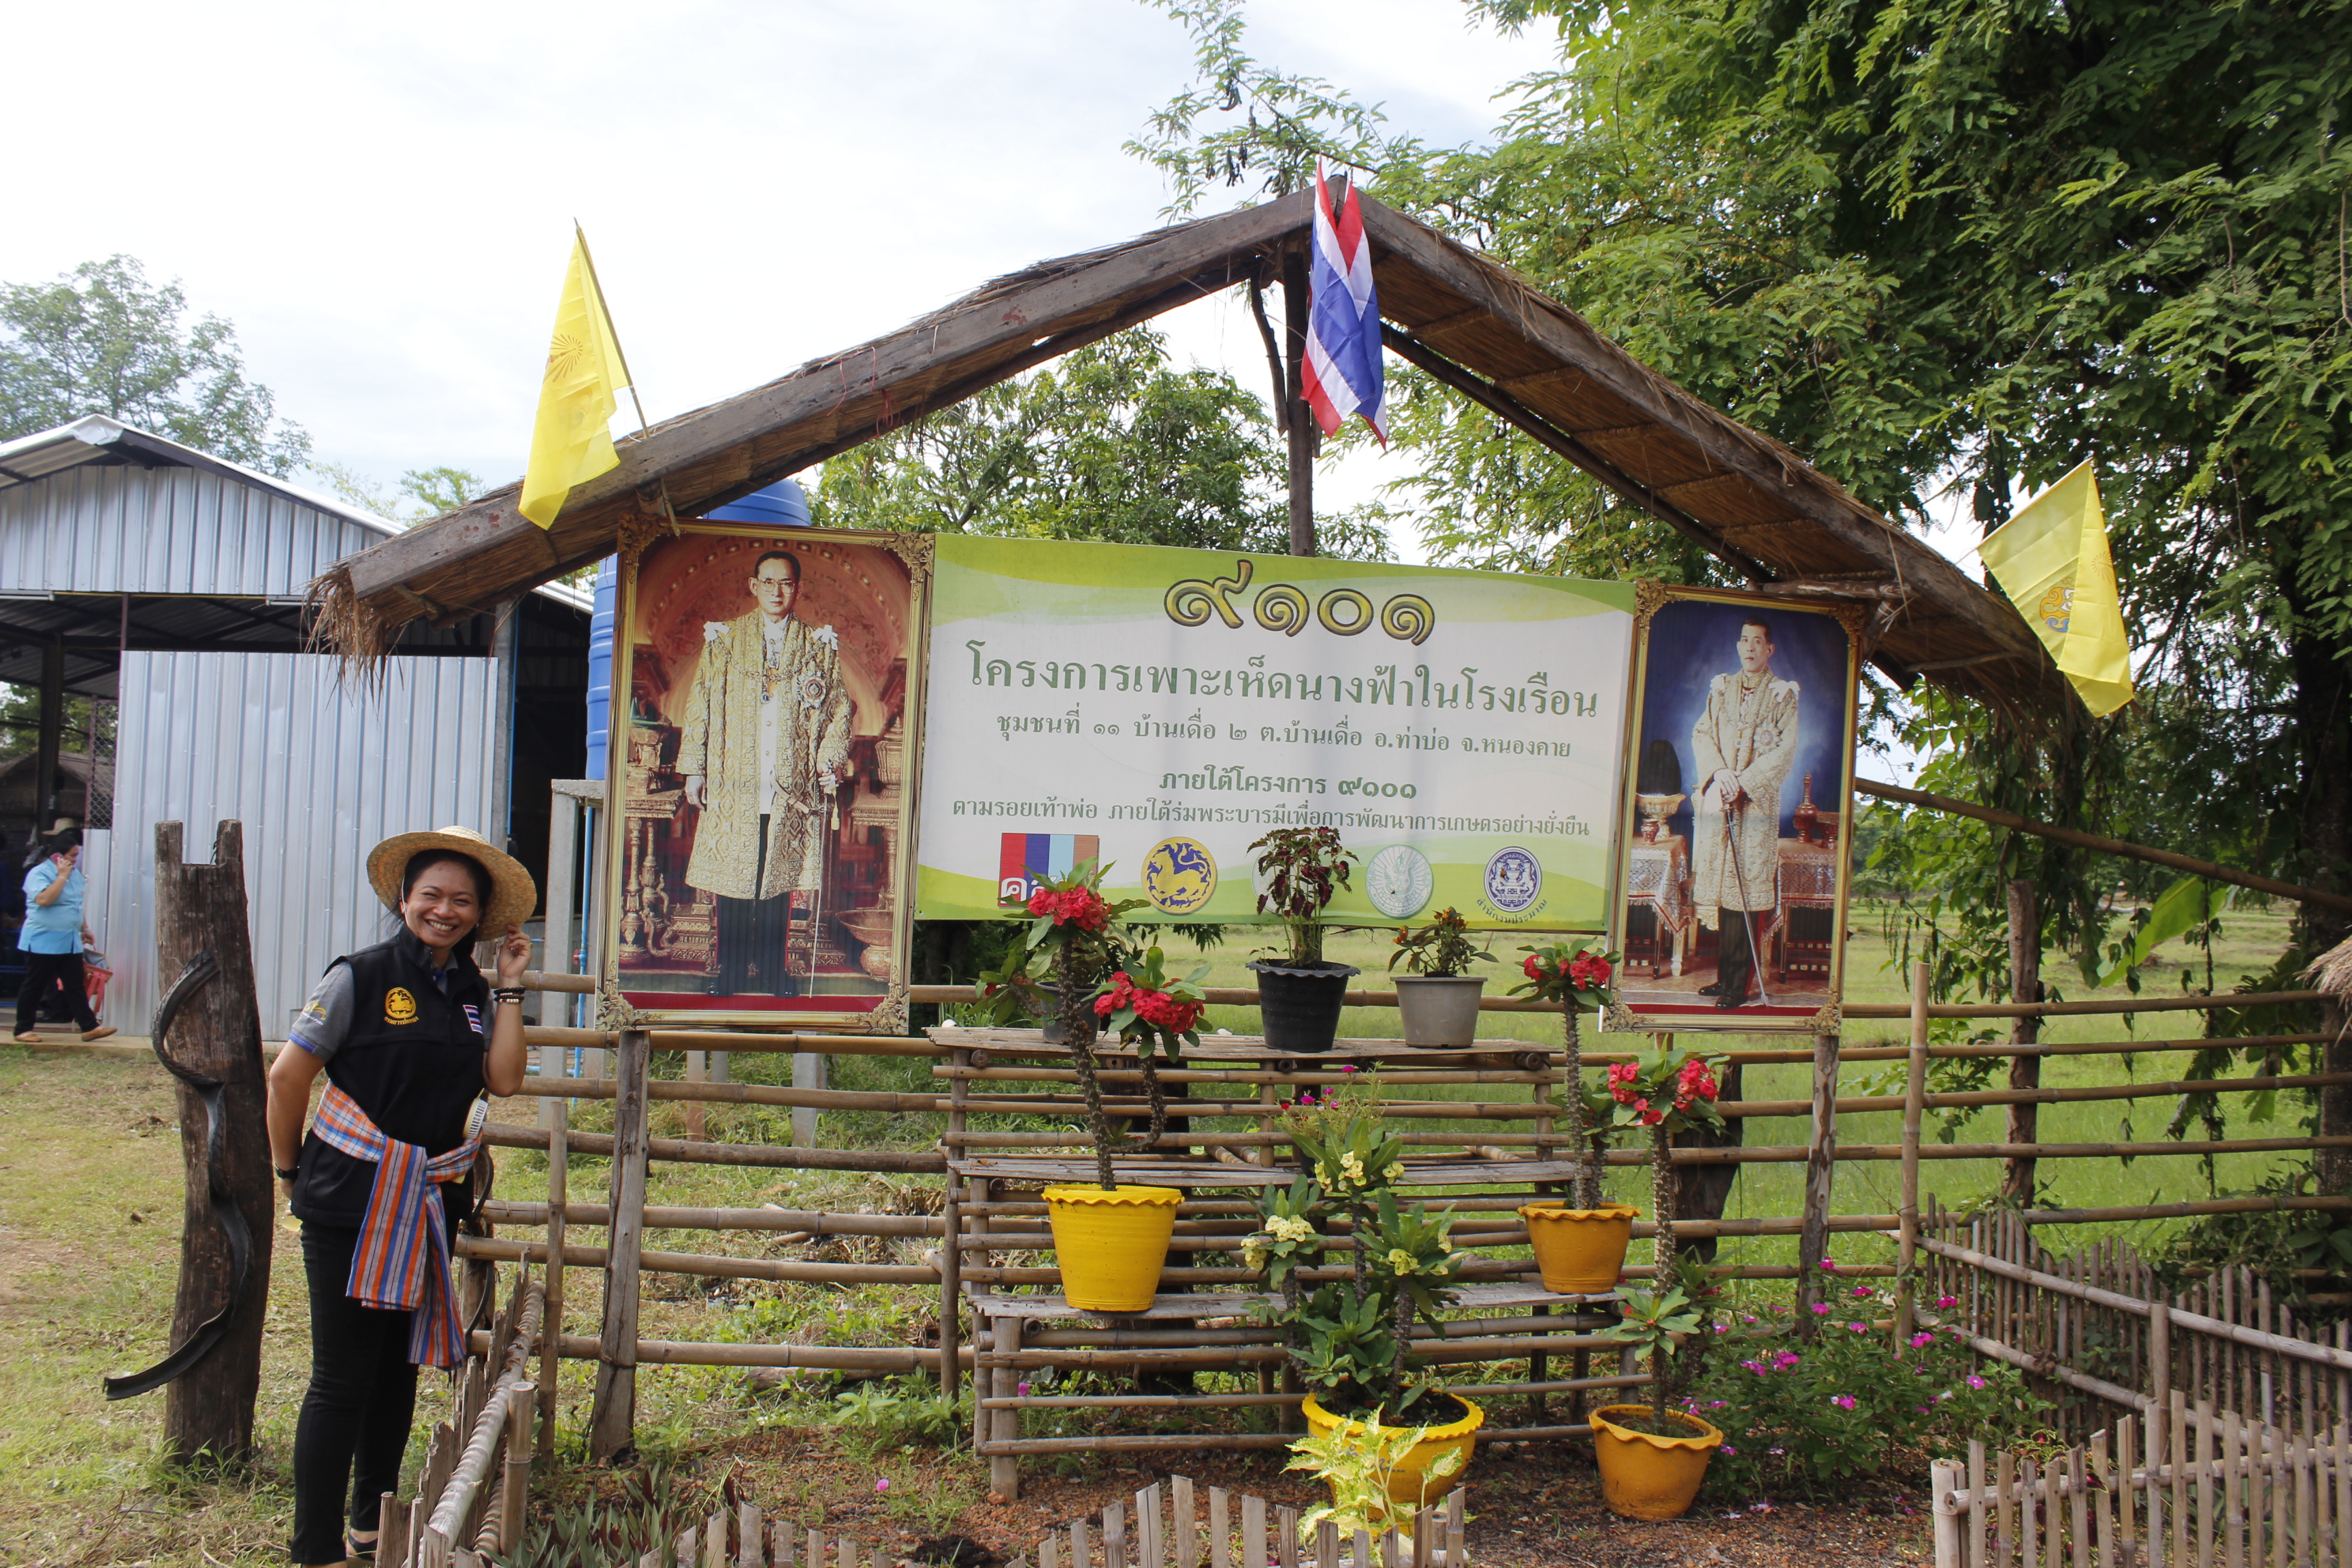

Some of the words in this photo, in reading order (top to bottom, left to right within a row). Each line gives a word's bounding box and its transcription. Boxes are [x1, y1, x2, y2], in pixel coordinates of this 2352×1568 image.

[1164, 559, 1435, 646] ๙๑๐๑
[965, 639, 1597, 717] โครงการเพาะเห็ดนางฟ้าในโรงเรือน
[997, 702, 1080, 741] ชุมชนที่
[1093, 723, 1120, 736] ๑๑
[1134, 708, 1216, 740] บ้านเดื่อ
[1229, 723, 1247, 740] ๒
[1260, 715, 1362, 747] ต.บ้านเดื่อ
[1375, 726, 1450, 751] อ.ท่าบ่อ
[1462, 738, 1571, 757] จ.หนองคาย
[1158, 764, 1327, 794] ภายใต้โครงการ
[1337, 777, 1417, 799] ๙๑๐๑
[953, 796, 1098, 818] ตามรอยเท้าพ่อ
[1108, 797, 1590, 836] ภายใต้ร่มพระบารมีเพื่อการพัฒนาการเกษตรอย่างยั่งยืน
